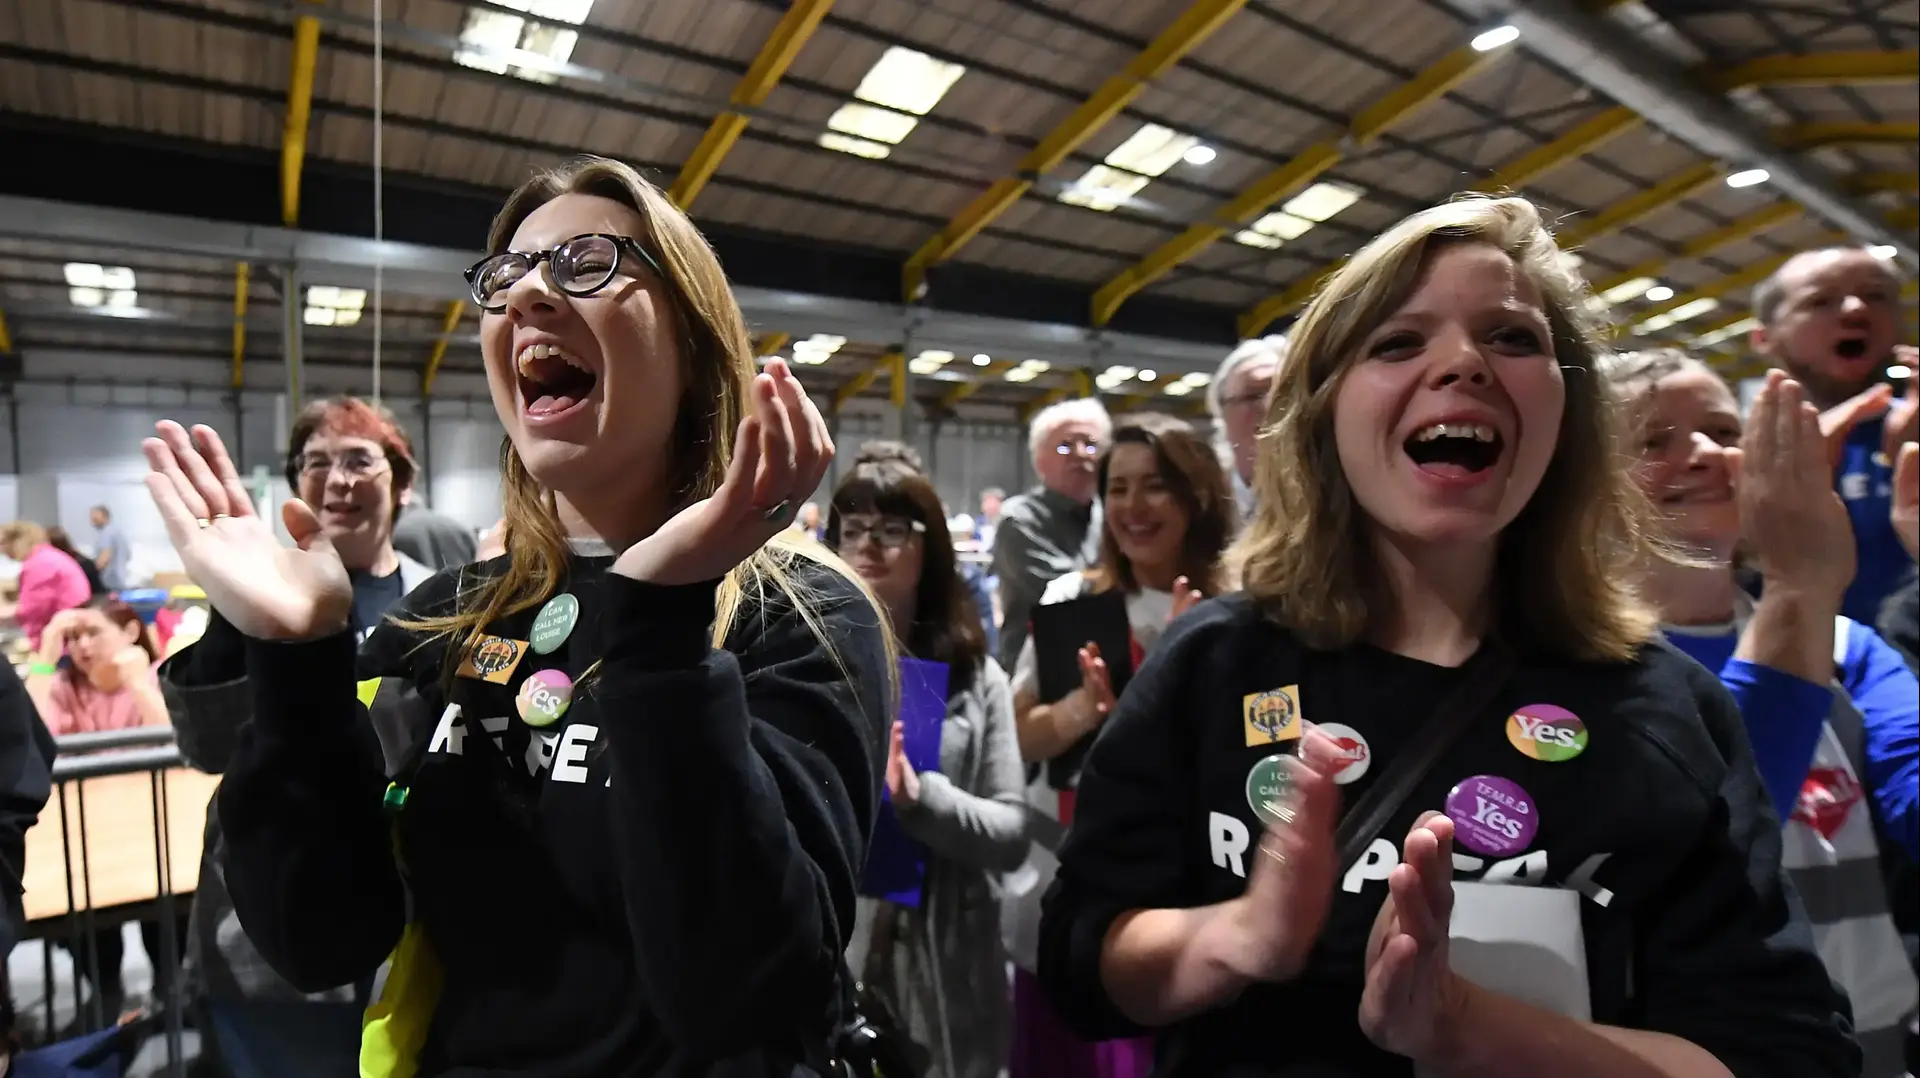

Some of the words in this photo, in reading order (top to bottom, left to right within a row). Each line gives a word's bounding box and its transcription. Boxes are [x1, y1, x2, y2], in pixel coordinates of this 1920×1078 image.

[548, 605, 564, 616] CAN
[534, 619, 552, 631] CALL
[536, 627, 561, 642] LOUISE
[524, 676, 561, 719] Yes.
[1514, 714, 1584, 751] Yes.
[1276, 771, 1293, 782] CA
[1258, 785, 1287, 797] CALL
[1472, 796, 1523, 839] Yes
[1208, 811, 1615, 907] RPAL
